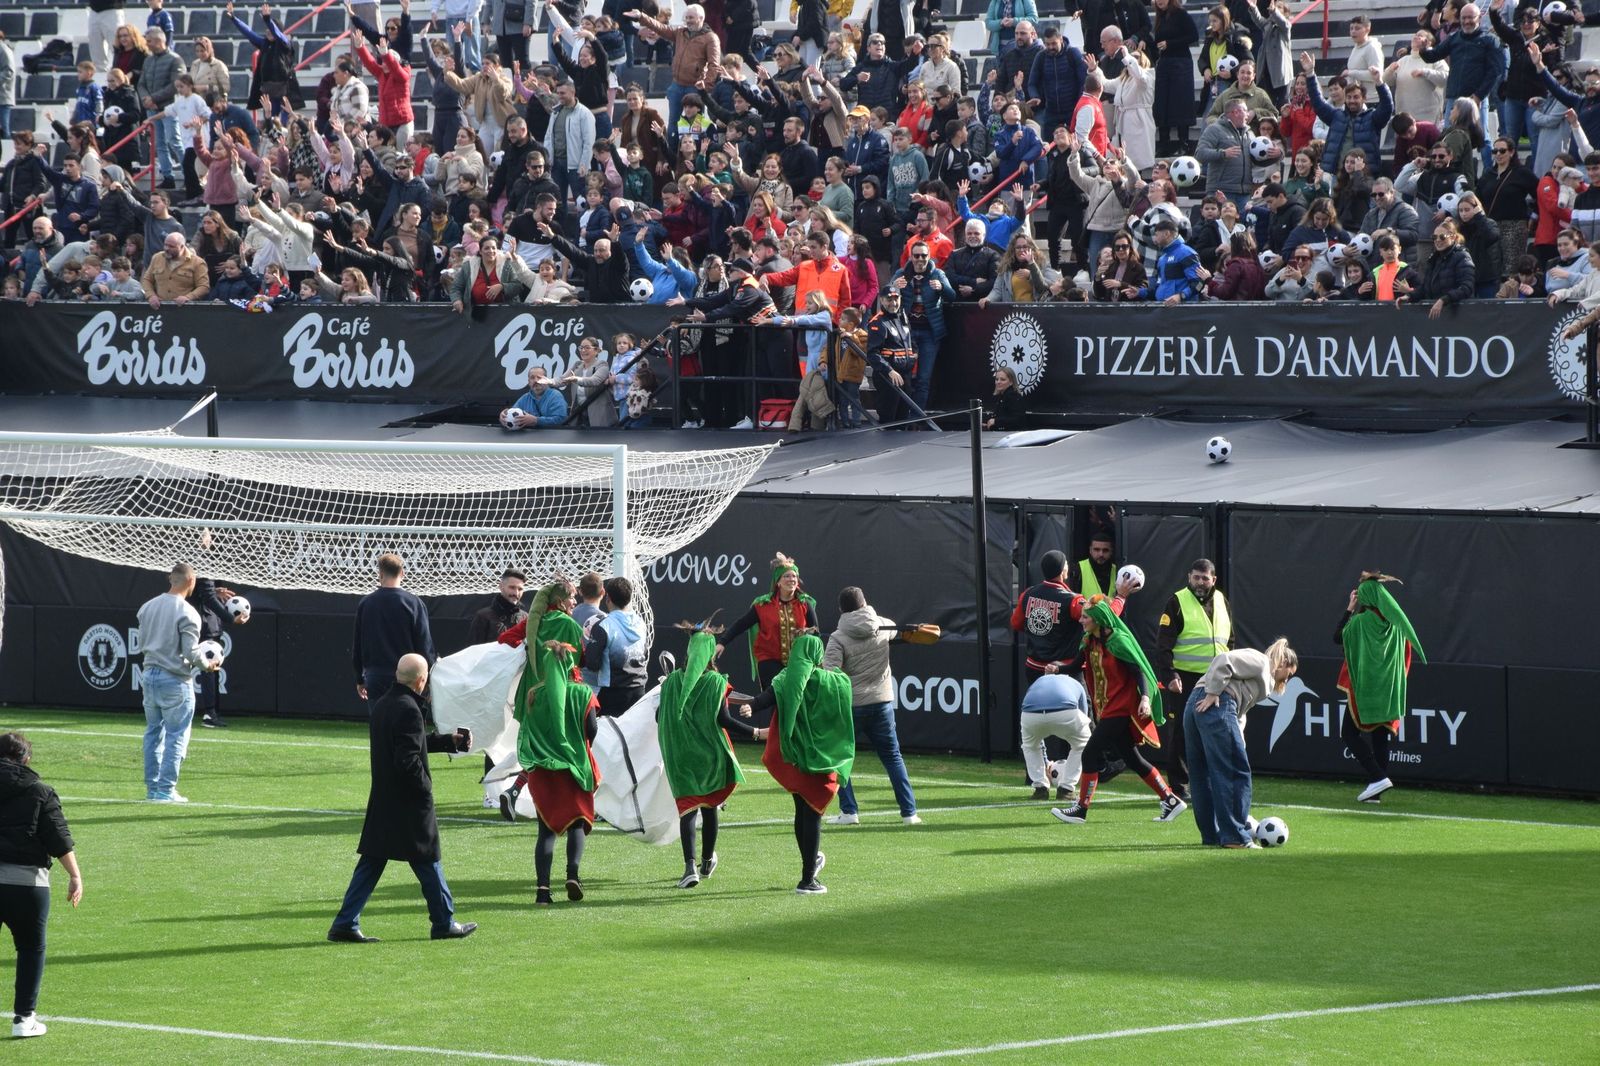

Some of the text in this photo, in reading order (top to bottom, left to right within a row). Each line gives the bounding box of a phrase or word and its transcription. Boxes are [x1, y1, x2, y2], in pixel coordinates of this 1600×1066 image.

[120, 315, 163, 338] Café
[327, 316, 371, 340] Café
[540, 317, 585, 342] Café
[1074, 326, 1515, 378] PIZZERÍA D'ARMANDO
[90, 676, 115, 686] CEUTA
[891, 675, 980, 715] cron
[1304, 699, 1467, 745] HITY
[1388, 750, 1422, 764] irlines
